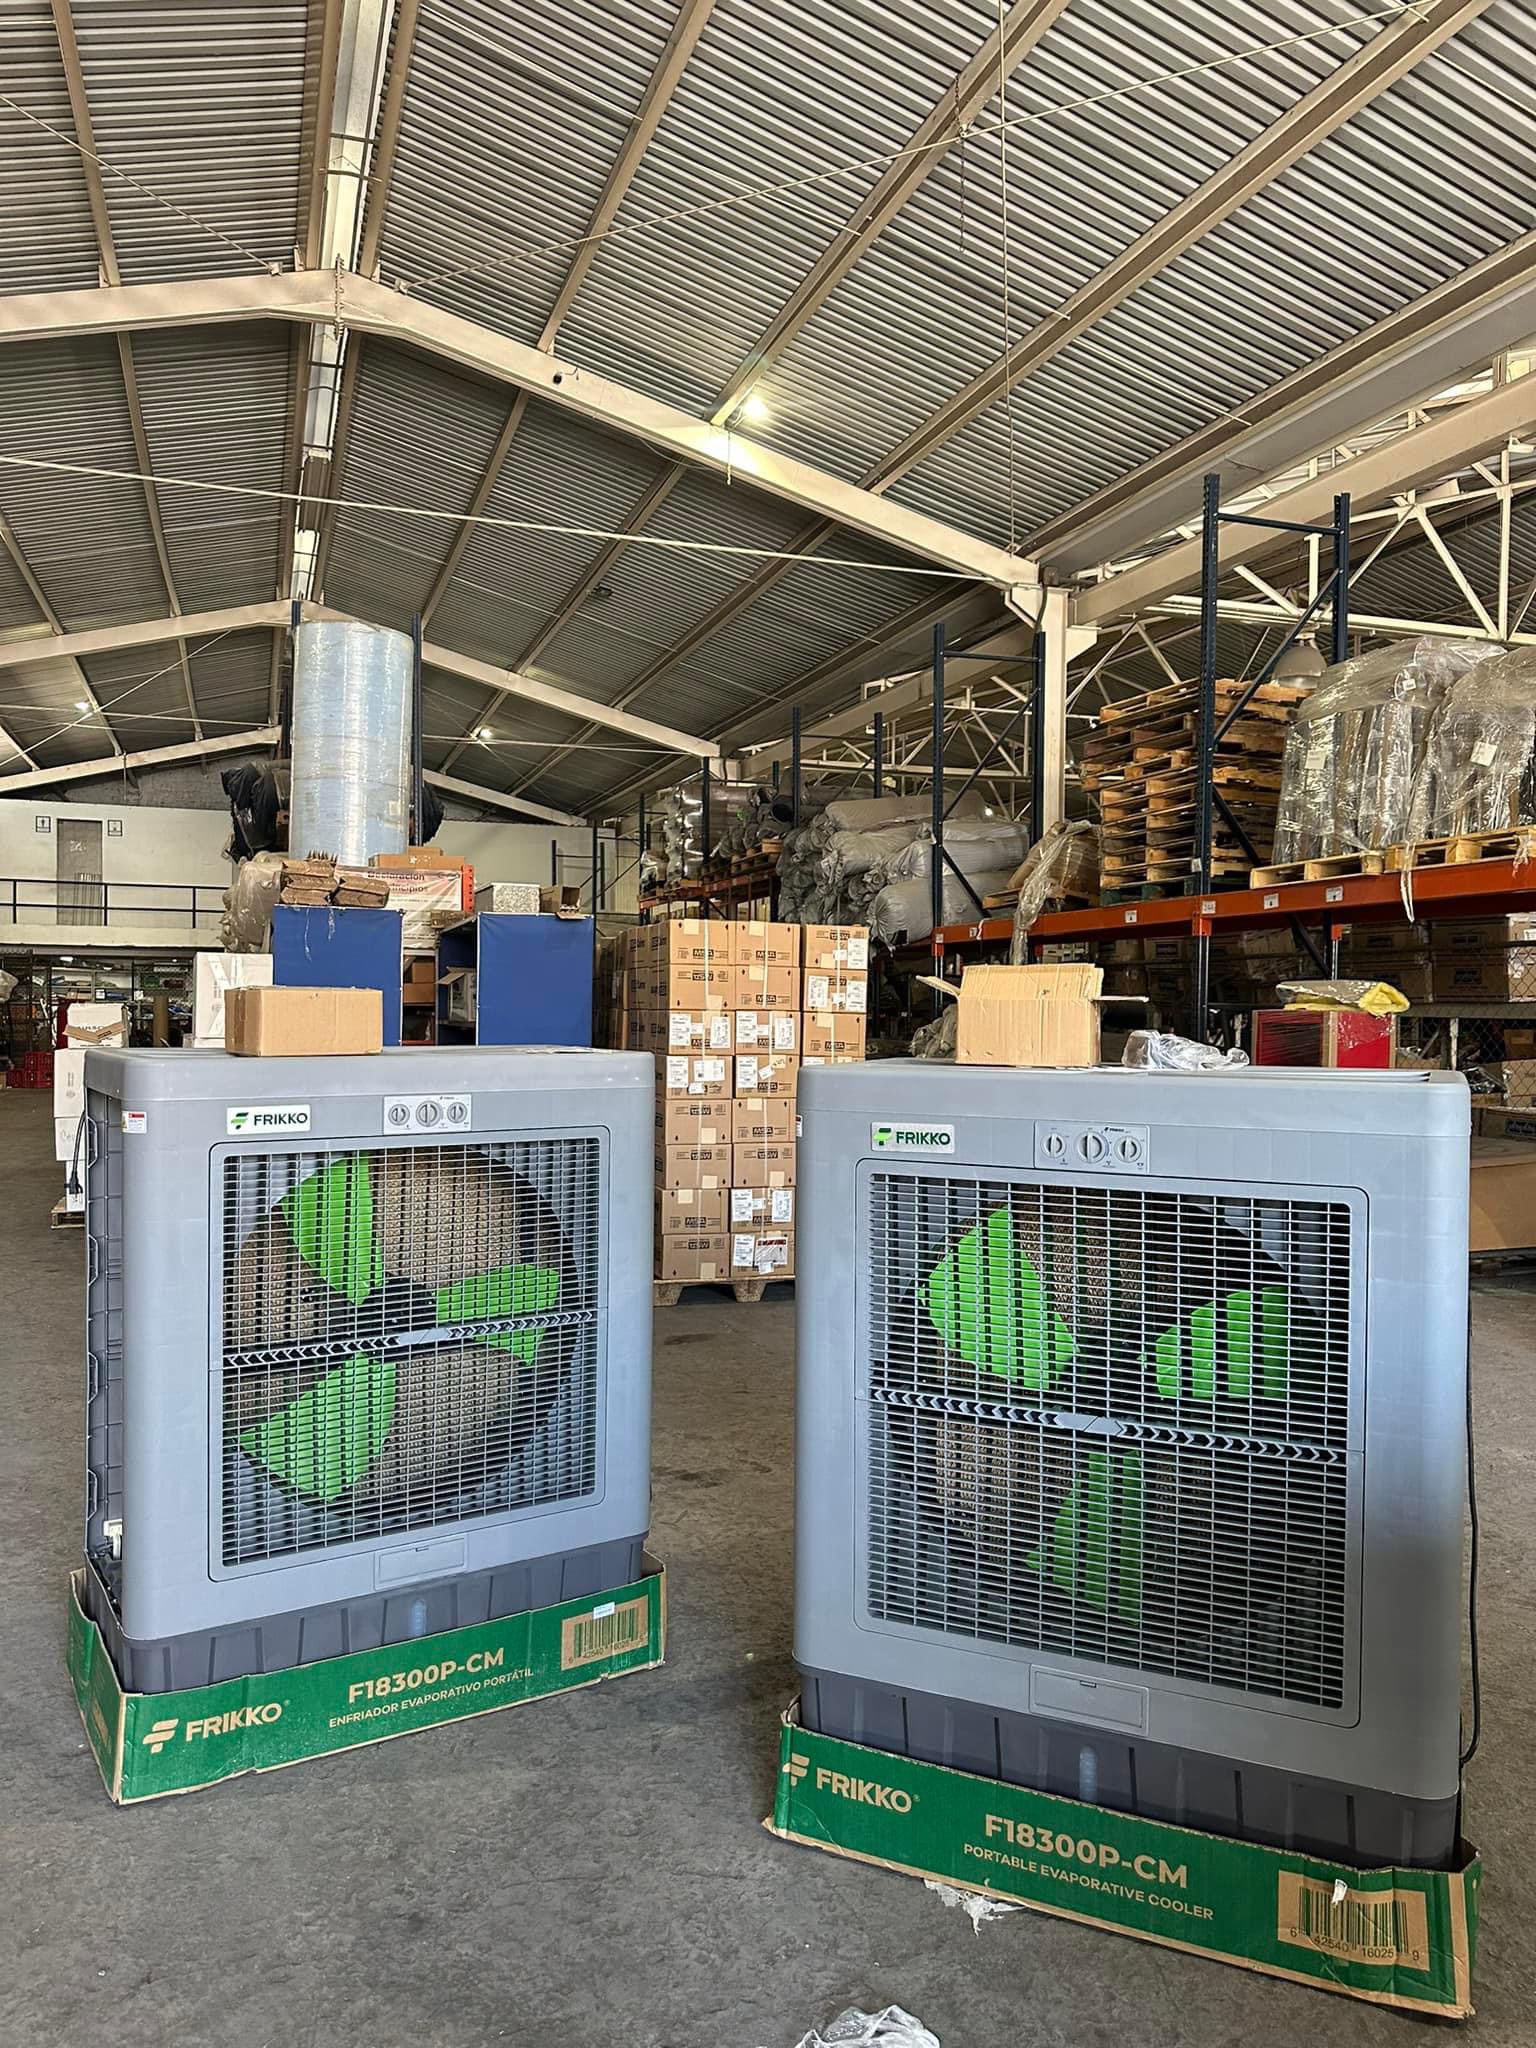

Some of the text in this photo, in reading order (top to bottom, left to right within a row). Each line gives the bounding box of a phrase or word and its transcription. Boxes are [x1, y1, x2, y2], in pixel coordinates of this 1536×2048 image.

[253, 1112, 308, 1126] FRIKKO
[896, 1131, 950, 1146] FRIKKO
[329, 1667, 534, 1728] ENFRIADOR EVAPORATIVO PORTÁTIL
[348, 1647, 505, 1704] F18300P-CM
[185, 1702, 282, 1742] FRIKKO
[816, 1767, 912, 1813] FRIKKO
[985, 1814, 1188, 1889] F18300P-CM
[963, 1843, 1214, 1921] PORTABLE EVAPORATIVE COOLER
[1290, 1926, 1420, 1961] 6 42540 16025 9
